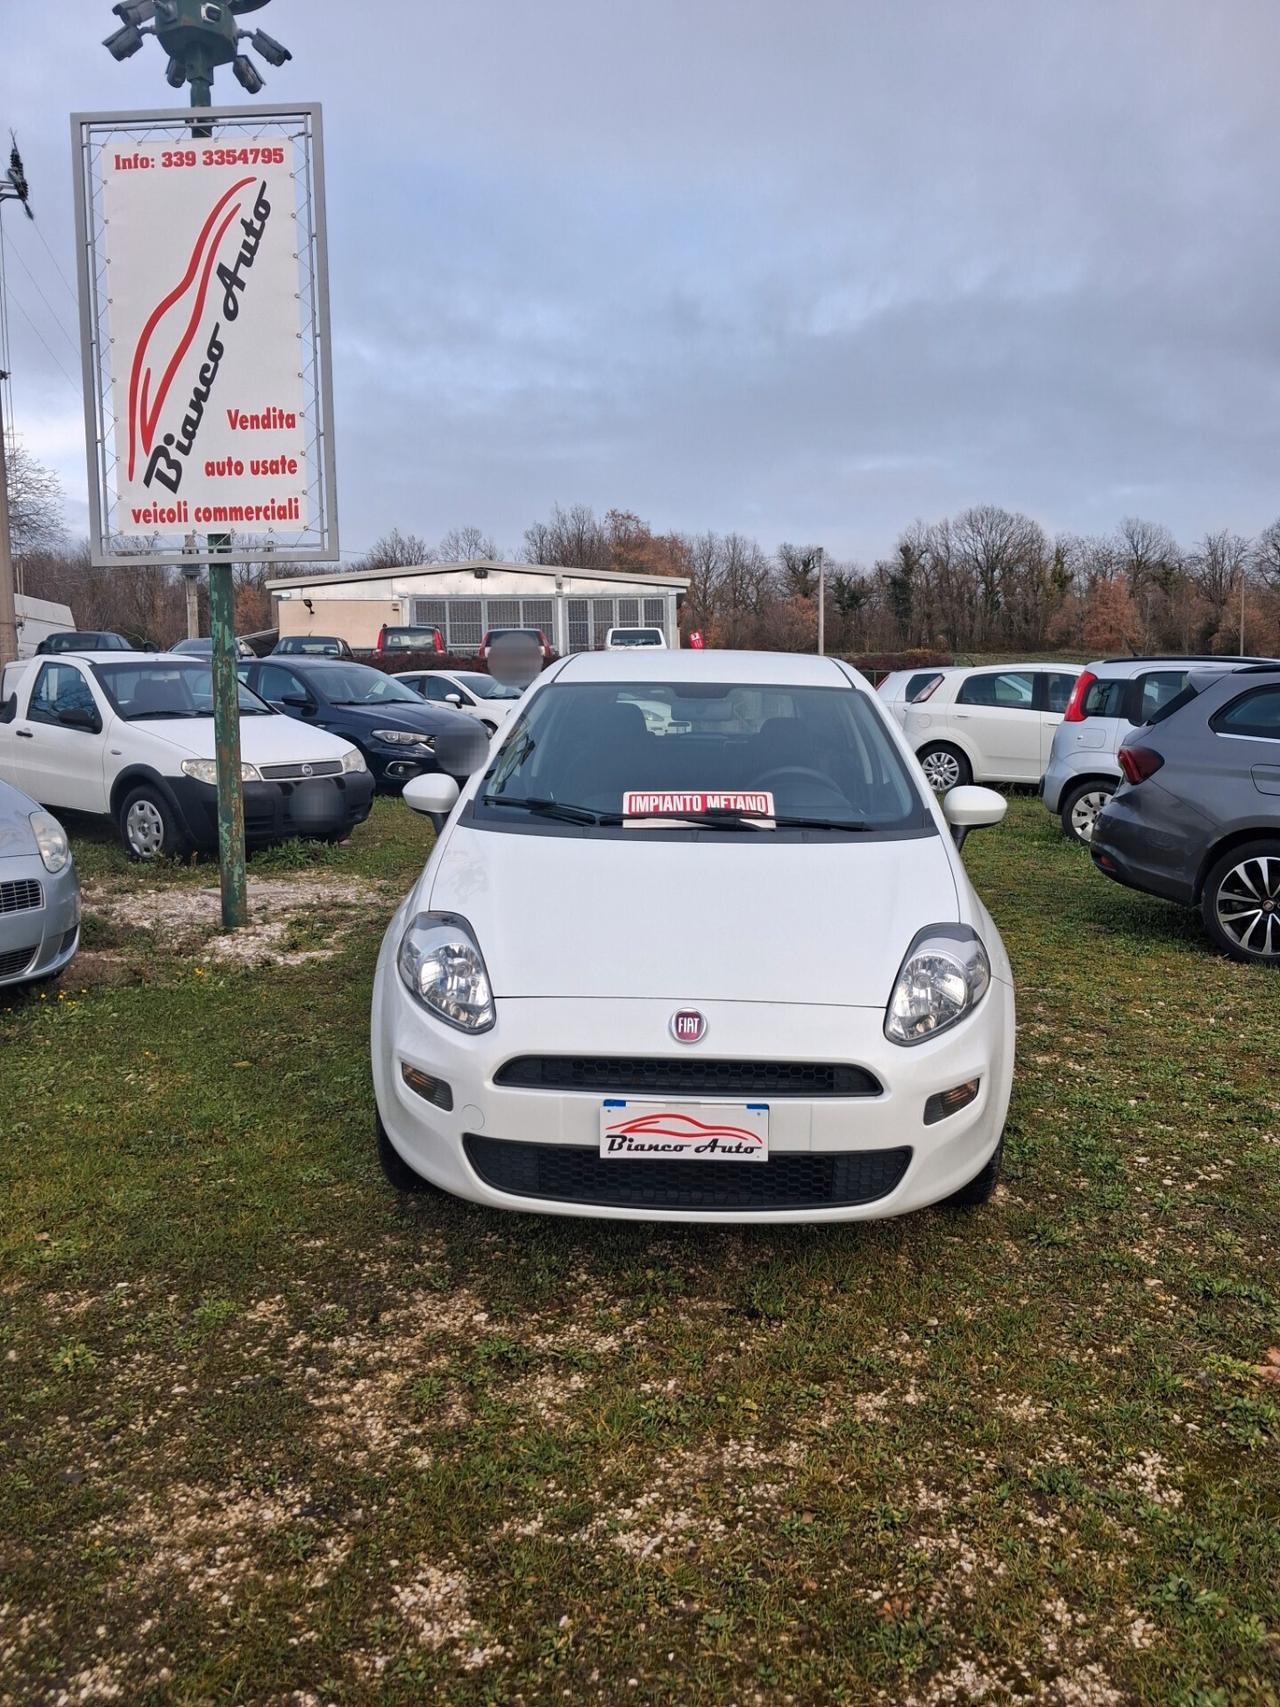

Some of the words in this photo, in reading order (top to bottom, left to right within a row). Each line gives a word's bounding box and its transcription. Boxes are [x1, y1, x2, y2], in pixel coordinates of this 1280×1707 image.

[115, 154, 155, 170] Info:
[161, 151, 197, 168] 339
[202, 148, 285, 166] 3354795
[143, 322, 225, 495] Bianco
[216, 180, 271, 322] Auto
[226, 406, 297, 431] Vendita
[204, 456, 244, 477] auto
[250, 455, 298, 476] usate
[131, 501, 189, 524] veicoli
[194, 497, 300, 522] commerciali
[631, 795, 702, 812] IMPIANTO
[678, 1017, 700, 1034] FIAT
[605, 1134, 692, 1152] Bianco
[694, 1138, 762, 1154] Auto
